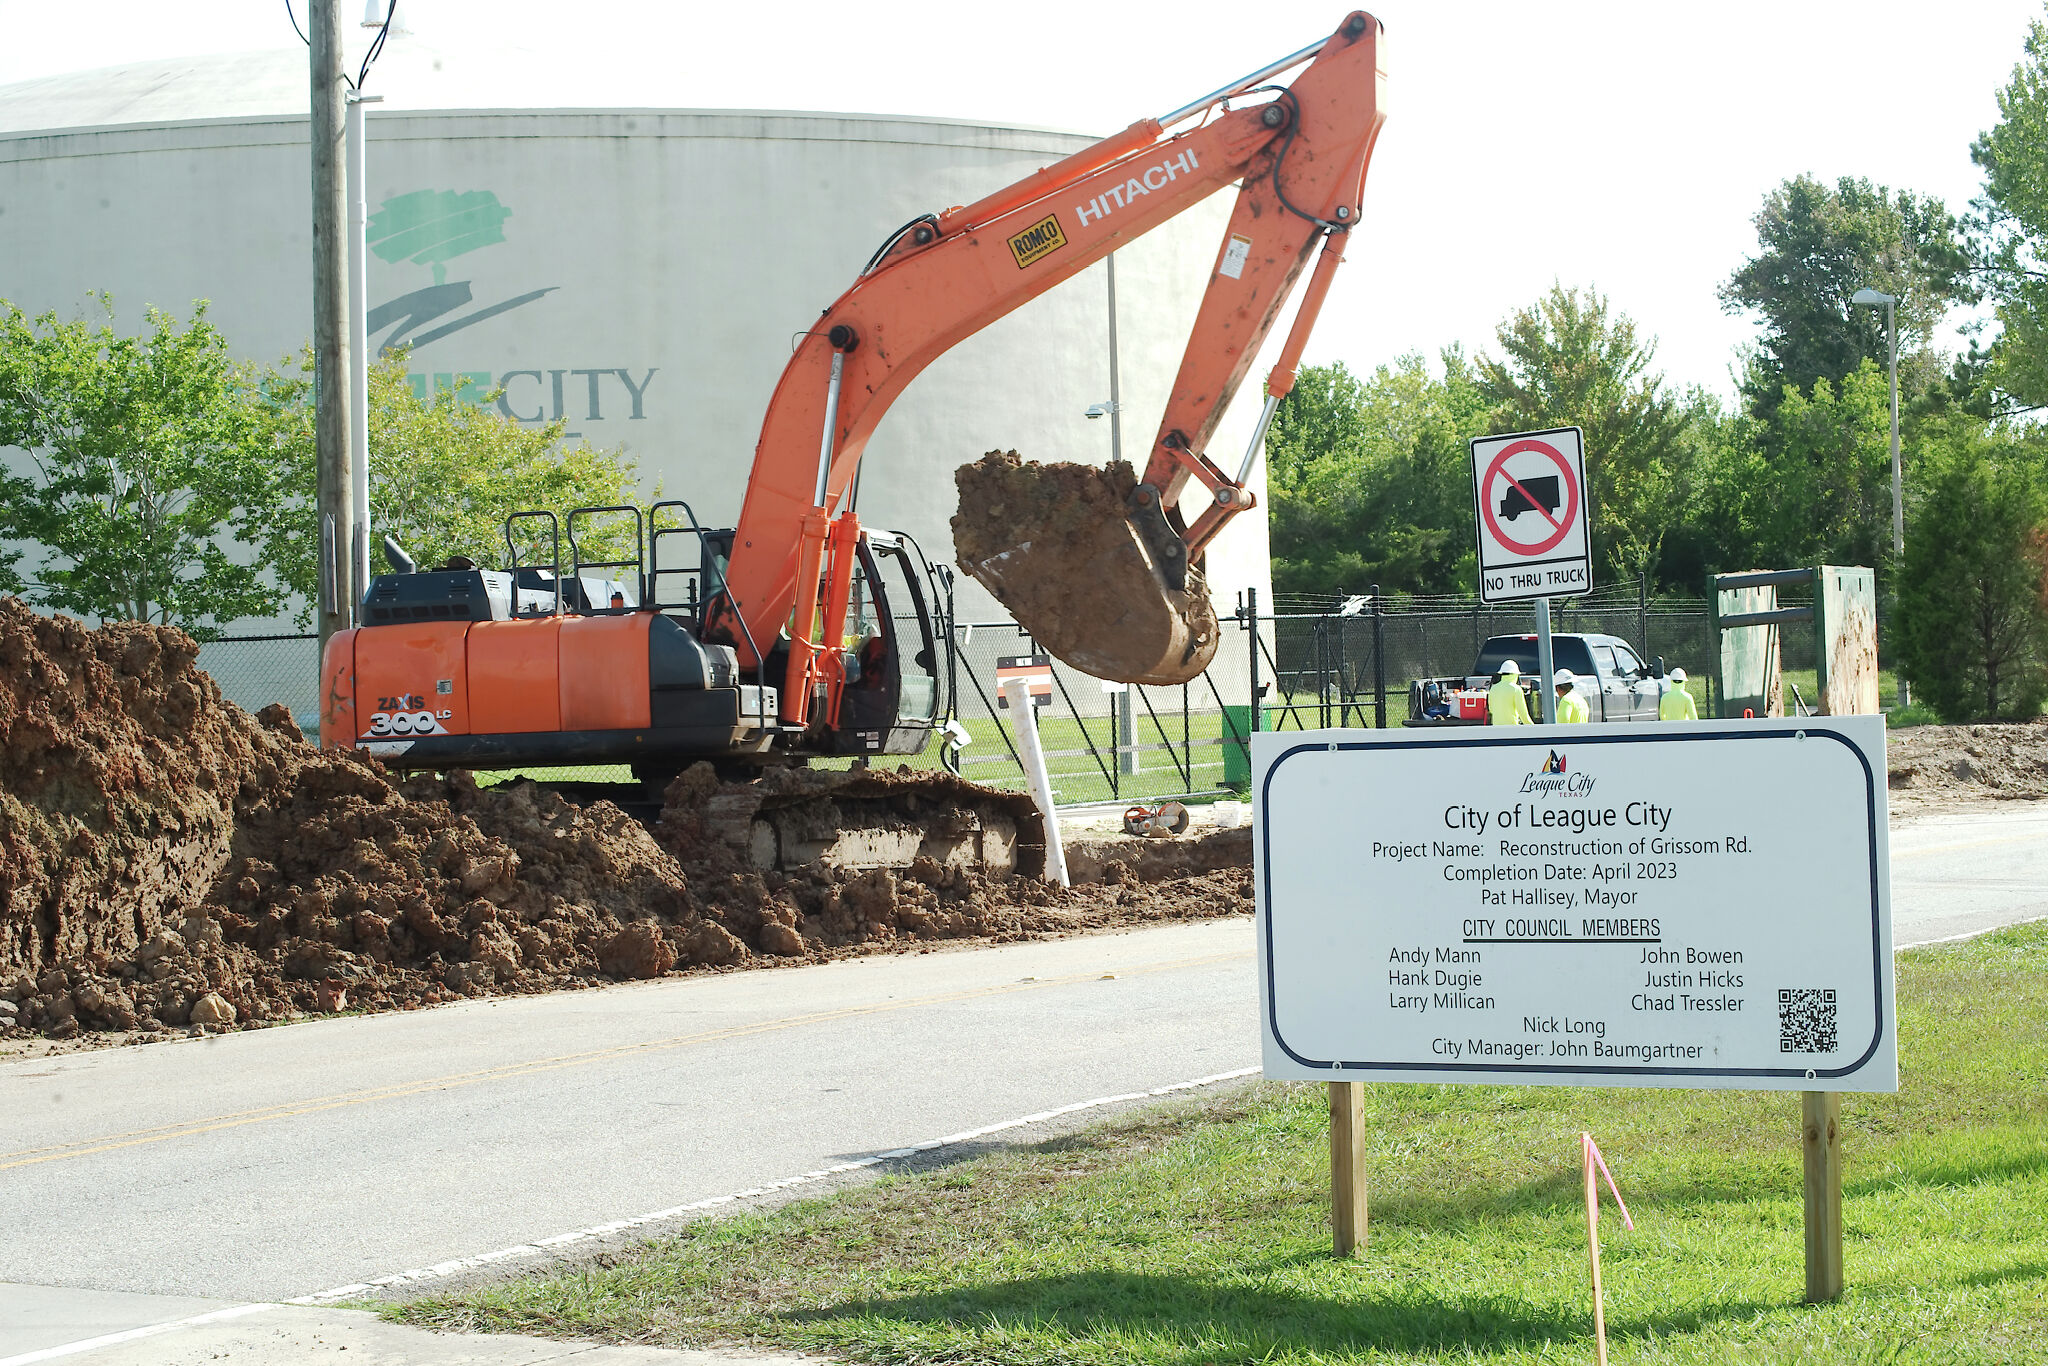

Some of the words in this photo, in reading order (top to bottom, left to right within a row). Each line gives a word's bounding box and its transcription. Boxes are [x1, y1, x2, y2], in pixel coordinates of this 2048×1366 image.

[1075, 148, 1199, 227] HITACHI
[1013, 221, 1058, 257] ROMCO
[1021, 243, 1051, 263] EQUIPMENT
[497, 367, 660, 422] CITY
[1486, 577, 1504, 592] NO
[1510, 573, 1541, 589] THRU
[1546, 569, 1585, 585] TRUCK
[378, 693, 425, 711] ZAXIS
[370, 711, 435, 736] 300
[436, 709, 452, 720] LC
[1518, 772, 1565, 800] League
[1567, 772, 1596, 798] City
[1444, 804, 1490, 836] City
[1497, 802, 1523, 829] of
[1530, 804, 1617, 835] League
[1625, 800, 1673, 832] City
[1372, 840, 1428, 863] Project
[1432, 840, 1484, 858] Name:
[1500, 837, 1623, 857] Reconstruction
[1628, 836, 1646, 855] of
[1650, 836, 1720, 855] Grissom
[1725, 835, 1752, 854] Rd.
[1443, 863, 1538, 886] Completion
[1544, 863, 1587, 881] Date:
[1591, 861, 1631, 885] April
[1636, 862, 1677, 880] 2023
[1481, 888, 1507, 906] Pat
[1512, 887, 1579, 910] Hallisey,
[1584, 888, 1638, 910] Mayor
[1462, 918, 1496, 937] CITY
[1505, 918, 1573, 937] COUNCIL
[1582, 918, 1661, 937] MEMBERS
[1388, 946, 1431, 968] Andy
[1435, 946, 1481, 964] Mann
[1640, 946, 1680, 964] John
[1686, 947, 1743, 964] Bowen
[1388, 969, 1430, 986] Hank
[1434, 969, 1482, 991] Dugie
[1644, 970, 1693, 988] Justin
[1699, 969, 1744, 988] Hicks
[1389, 992, 1429, 1014] Larry
[1433, 991, 1495, 1010] Millican
[1631, 993, 1675, 1012] Chad
[1679, 993, 1745, 1012] Tressler
[1523, 1015, 1560, 1033] Nick
[1565, 1016, 1606, 1039] Long
[1431, 1037, 1463, 1060] City
[1468, 1038, 1544, 1061] Manager:
[1549, 1039, 1586, 1057] John
[1594, 1040, 1704, 1063] Baumgartner
